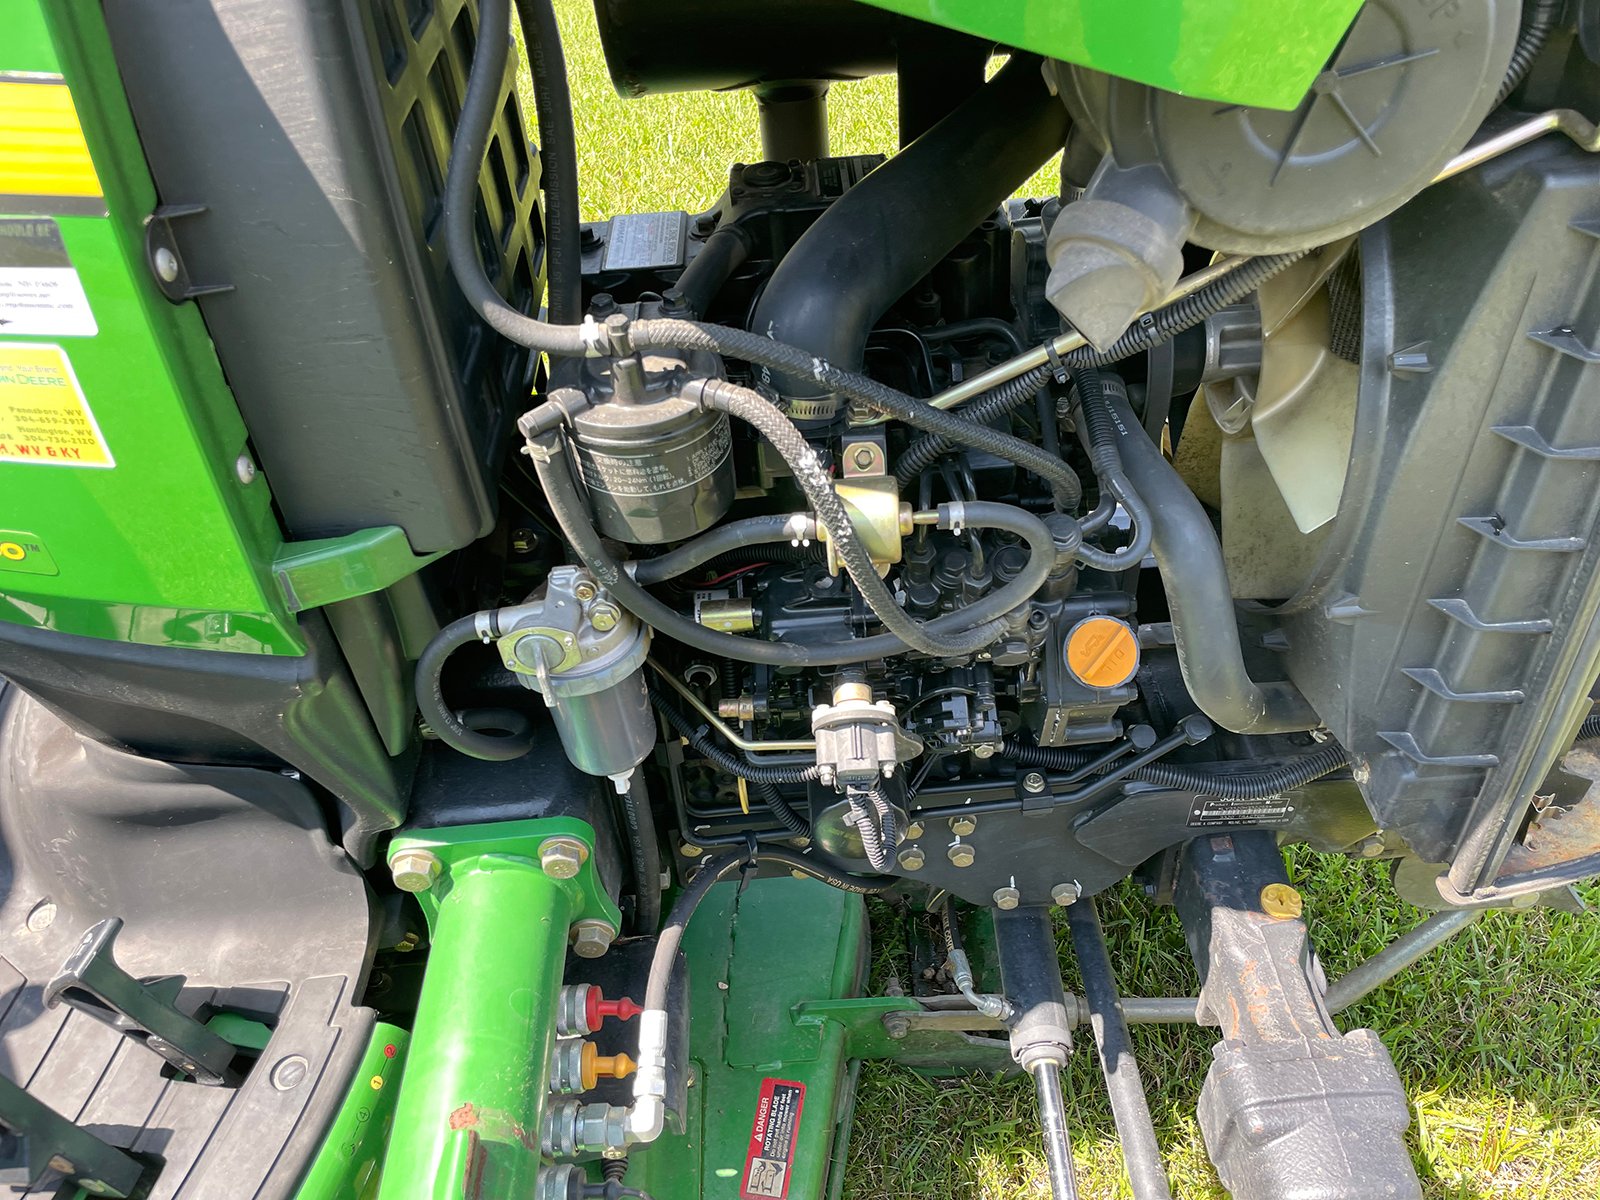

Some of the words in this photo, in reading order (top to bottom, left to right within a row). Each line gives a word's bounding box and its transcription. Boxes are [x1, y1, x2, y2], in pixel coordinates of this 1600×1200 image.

[532, 42, 547, 77] MADE
[545, 121, 555, 144] SAE
[549, 152, 561, 241] FUEL/EMISSION
[46, 446, 57, 458] &
[60, 447, 81, 459] KY
[826, 876, 841, 888] USA
[757, 1097, 769, 1132] DANGER
[765, 1118, 775, 1151] ROTATING
